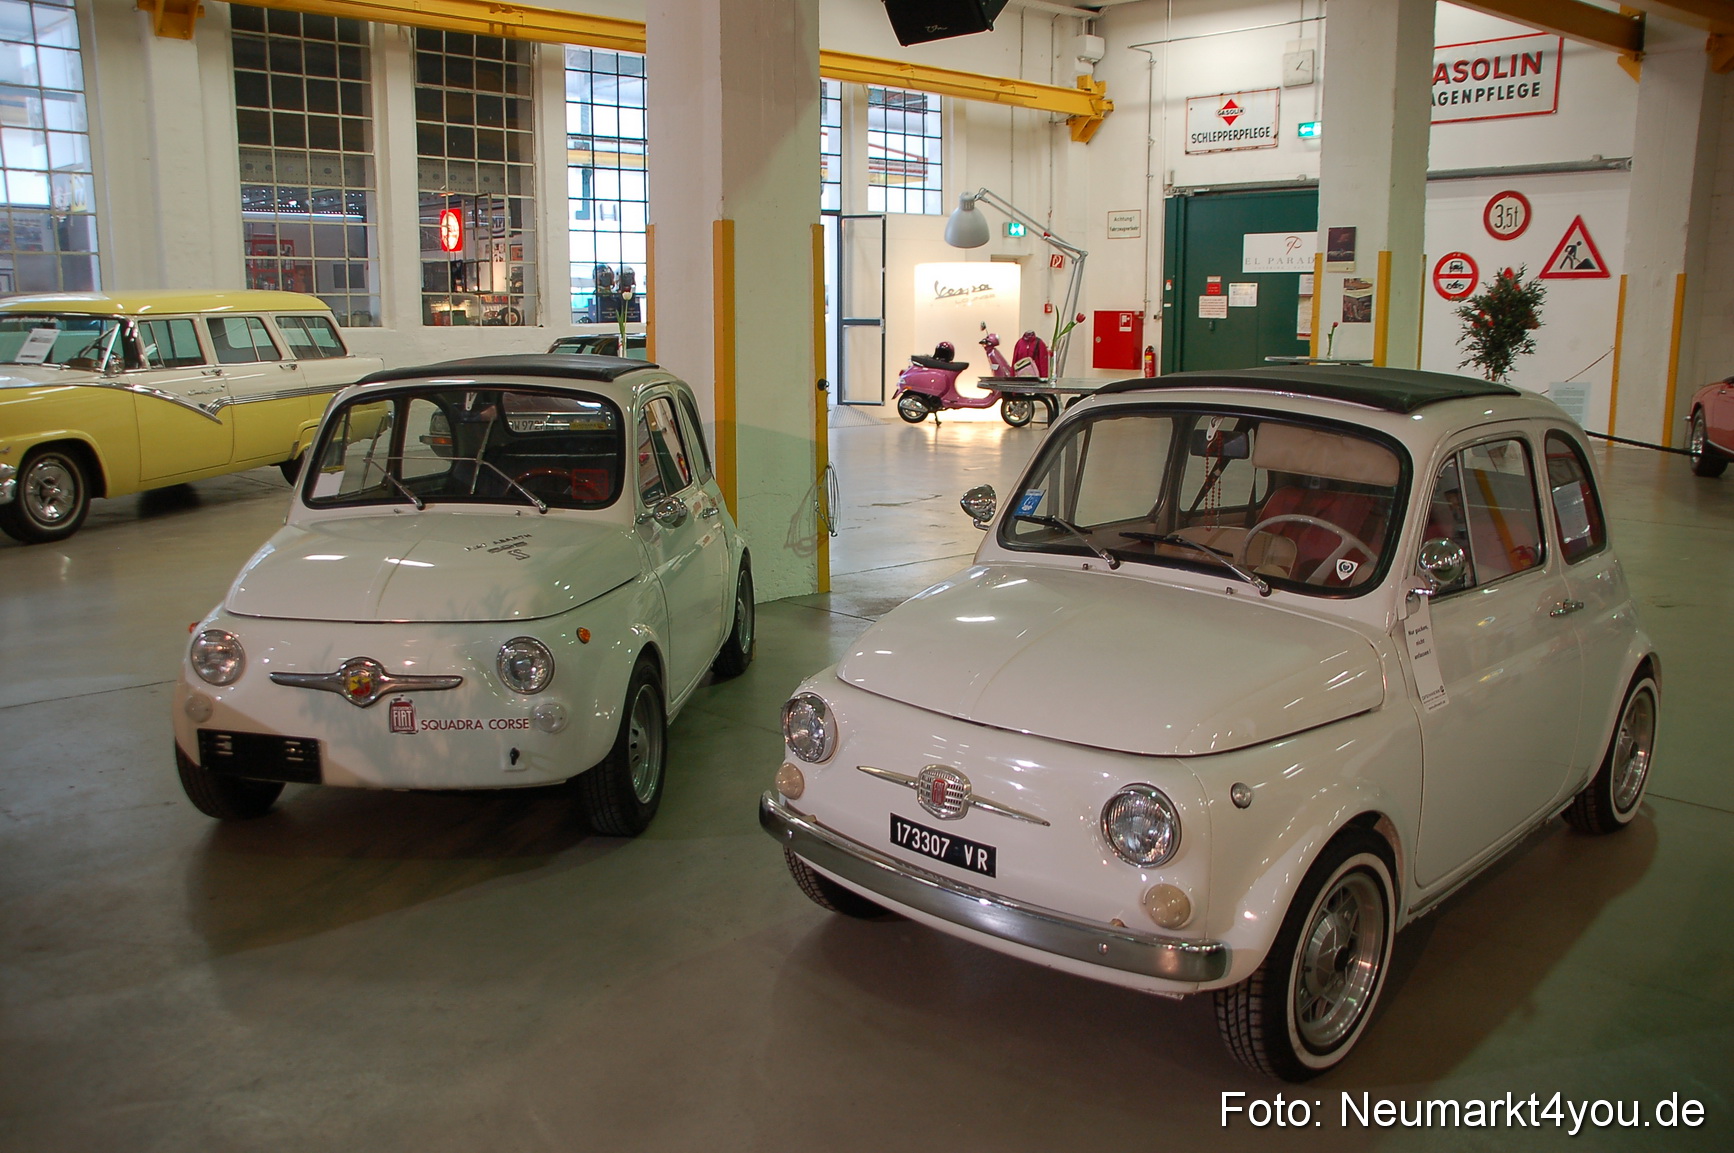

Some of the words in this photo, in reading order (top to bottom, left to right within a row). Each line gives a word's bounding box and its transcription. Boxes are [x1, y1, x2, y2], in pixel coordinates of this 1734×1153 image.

[1191, 126, 1271, 144] SCHLEPPERPFLEGE
[1494, 203, 1519, 230] 3,5t
[1244, 257, 1261, 266] EL
[393, 710, 412, 727] FIAT
[421, 719, 483, 730] SQUADRA
[488, 718, 529, 730] CORSE
[897, 821, 950, 858] 173307
[964, 844, 988, 872] VR
